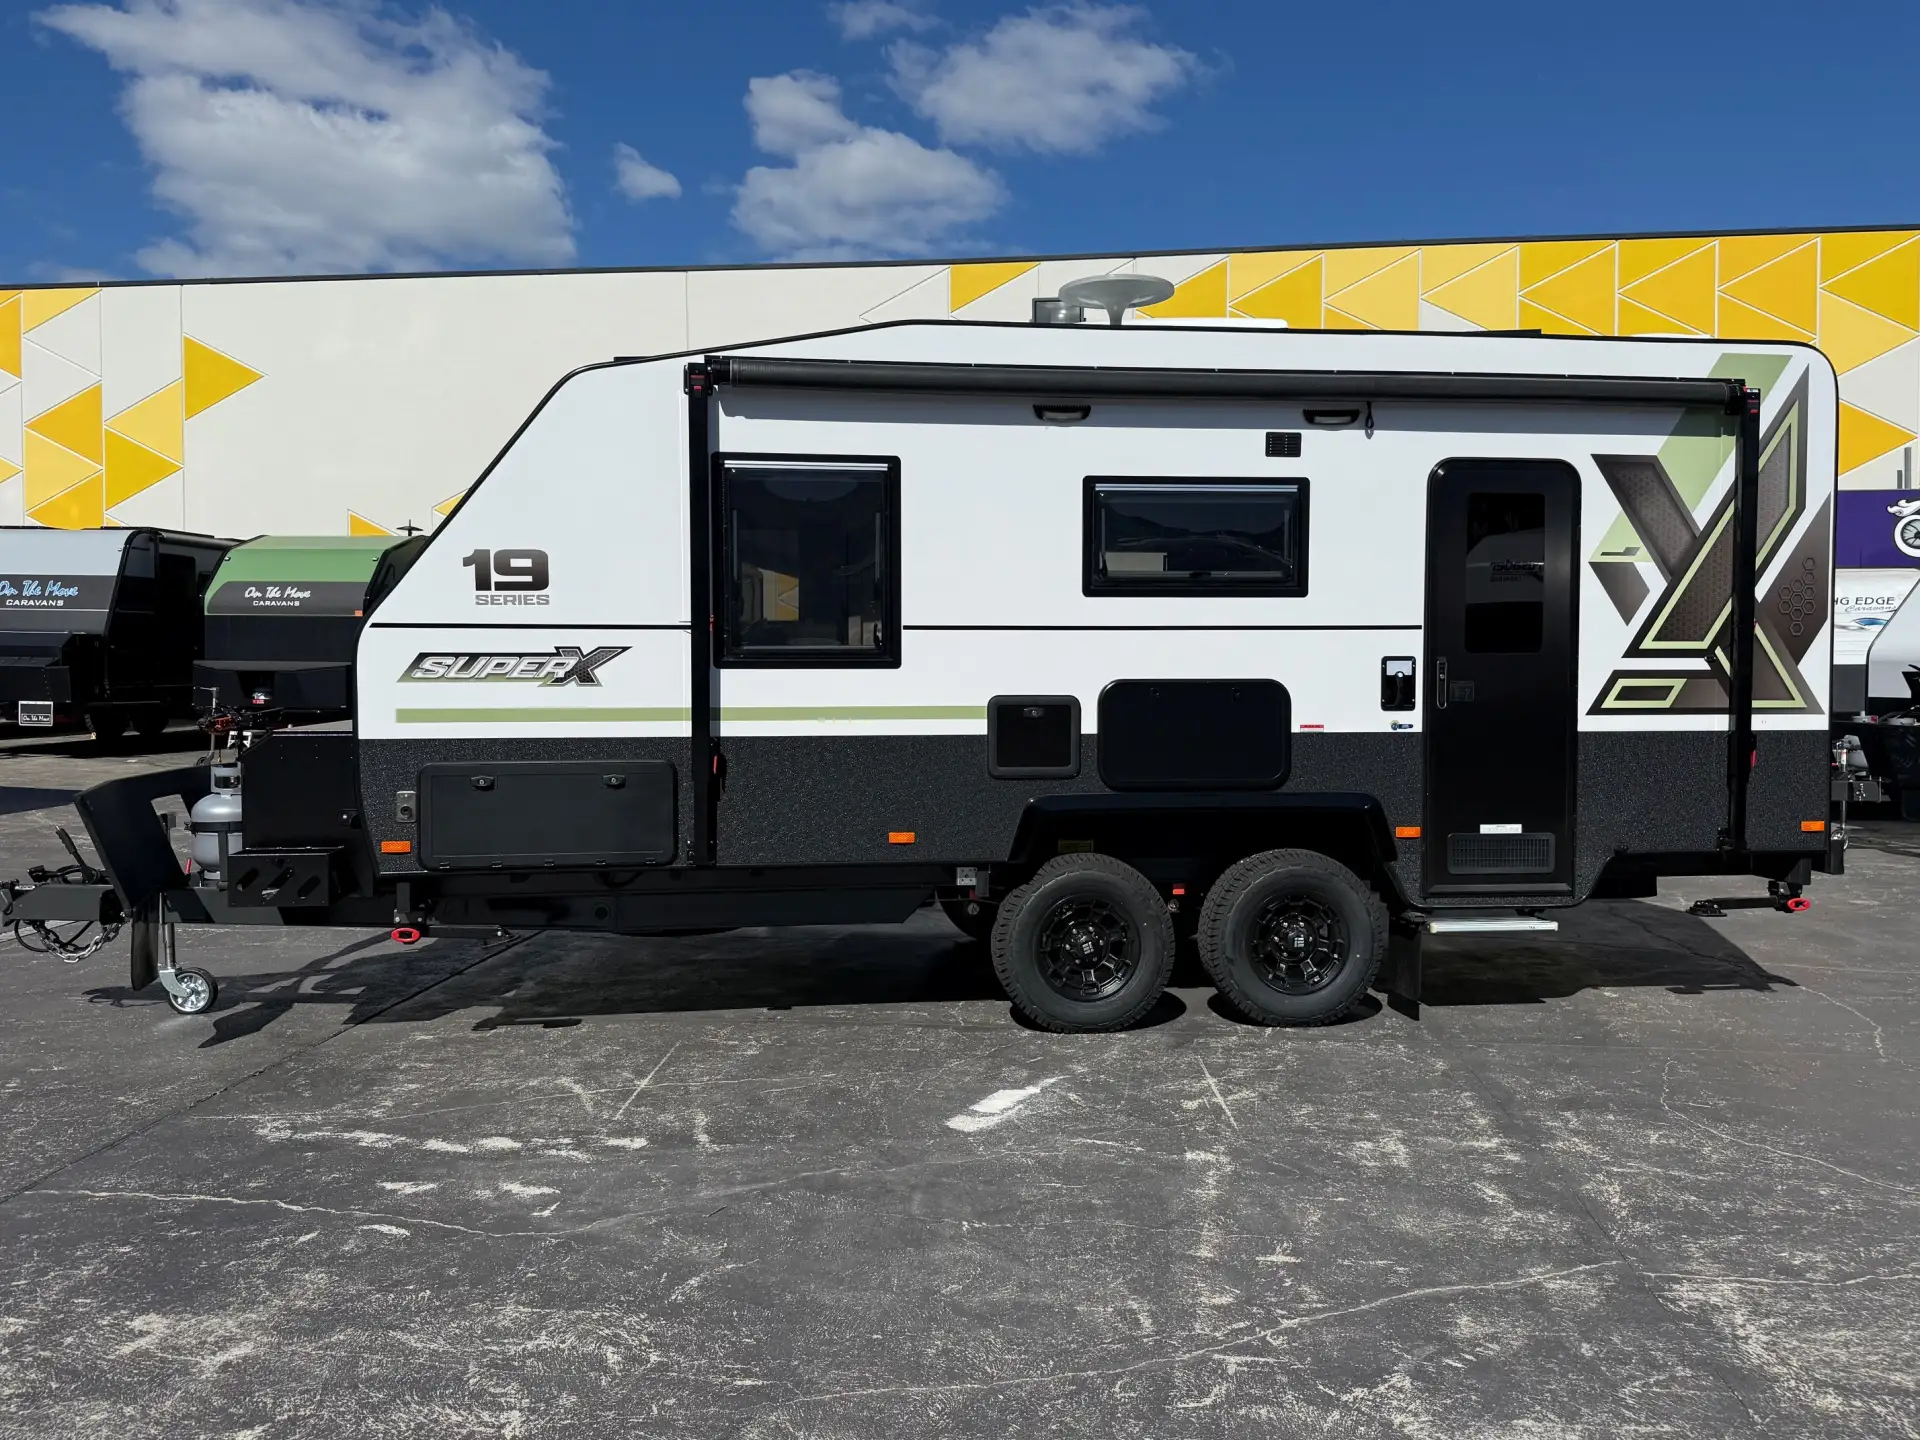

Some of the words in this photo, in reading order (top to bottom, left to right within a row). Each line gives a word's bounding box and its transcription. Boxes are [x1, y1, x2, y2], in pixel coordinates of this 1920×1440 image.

[462, 549, 549, 591] 19
[0, 580, 18, 596] On
[22, 580, 42, 597] The
[45, 580, 79, 597] Move
[244, 586, 263, 598] On
[265, 586, 282, 598] The
[284, 586, 311, 598] Move
[6, 599, 64, 607] CARAVANS
[475, 594, 550, 606] SERIES
[1855, 596, 1896, 606] EDGE
